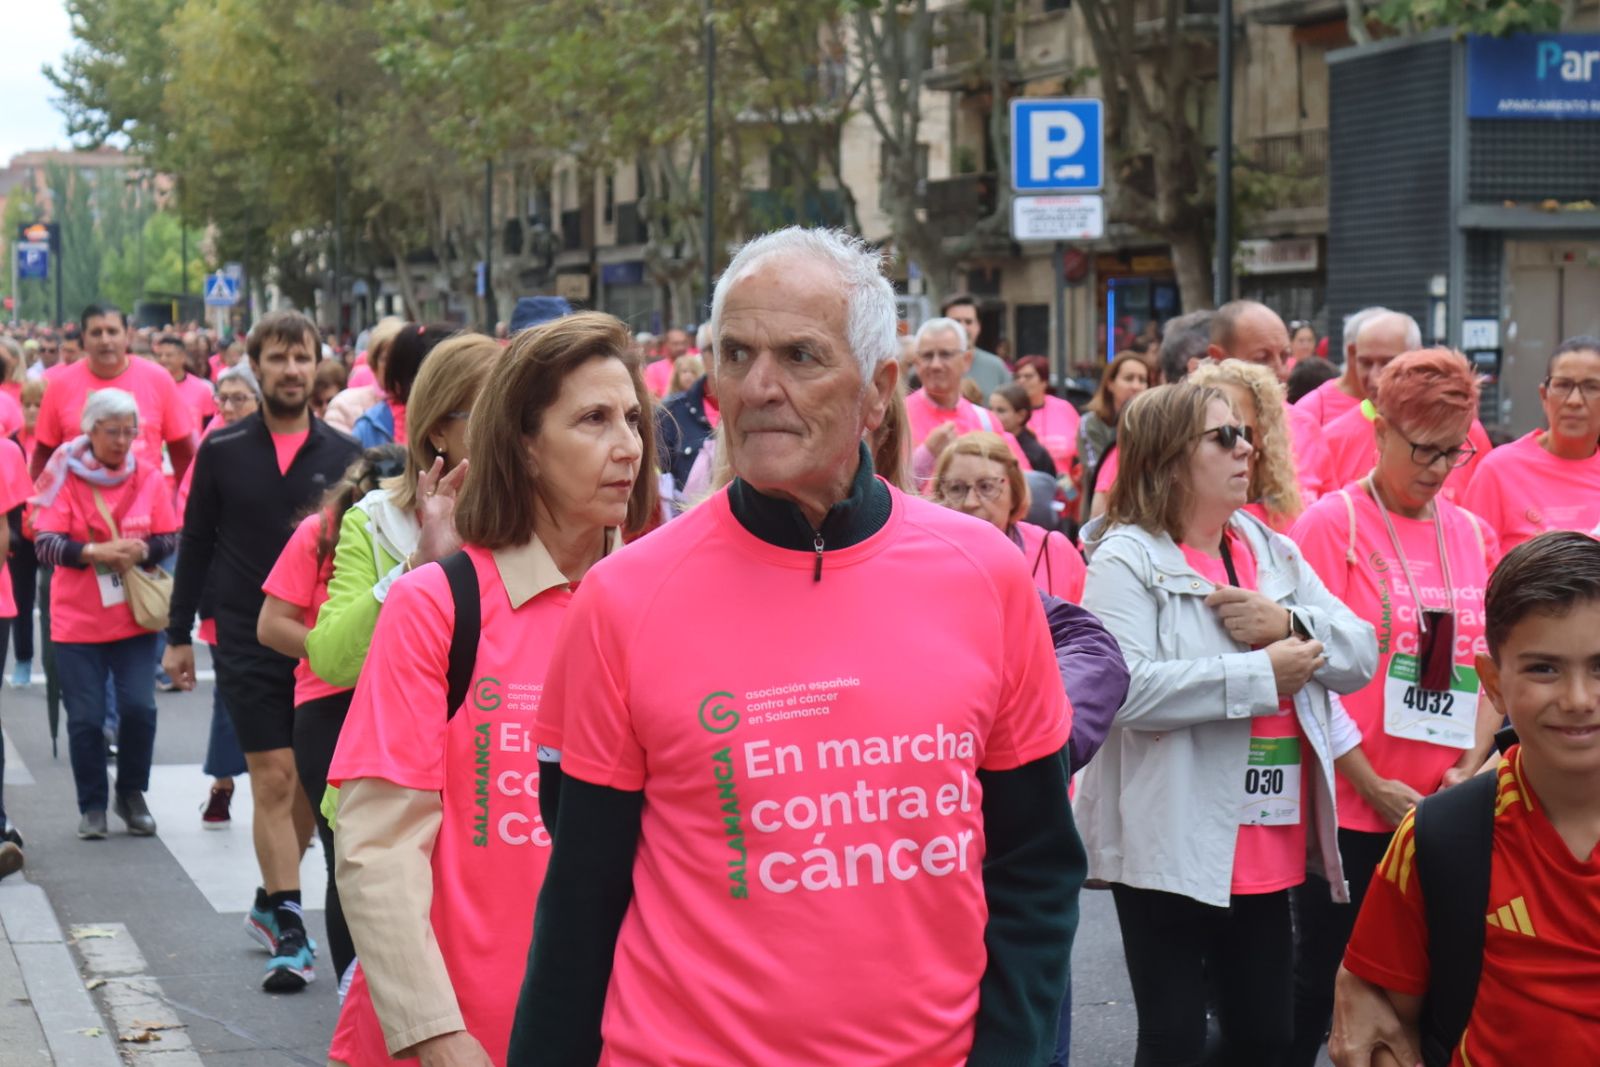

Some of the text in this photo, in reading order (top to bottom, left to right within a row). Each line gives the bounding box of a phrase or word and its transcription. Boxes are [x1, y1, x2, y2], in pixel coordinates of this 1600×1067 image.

[1030, 110, 1085, 180] P
[745, 676, 860, 700] asociación española
[746, 691, 838, 712] contra el cáncer
[748, 707, 830, 725] en Salamanca
[1403, 686, 1454, 717] 4032
[743, 723, 974, 779] En marcha
[473, 722, 491, 847] SALAMANCA
[751, 770, 971, 833] contra el
[712, 746, 748, 900] SALAMANCA
[758, 829, 973, 894] cáncer
